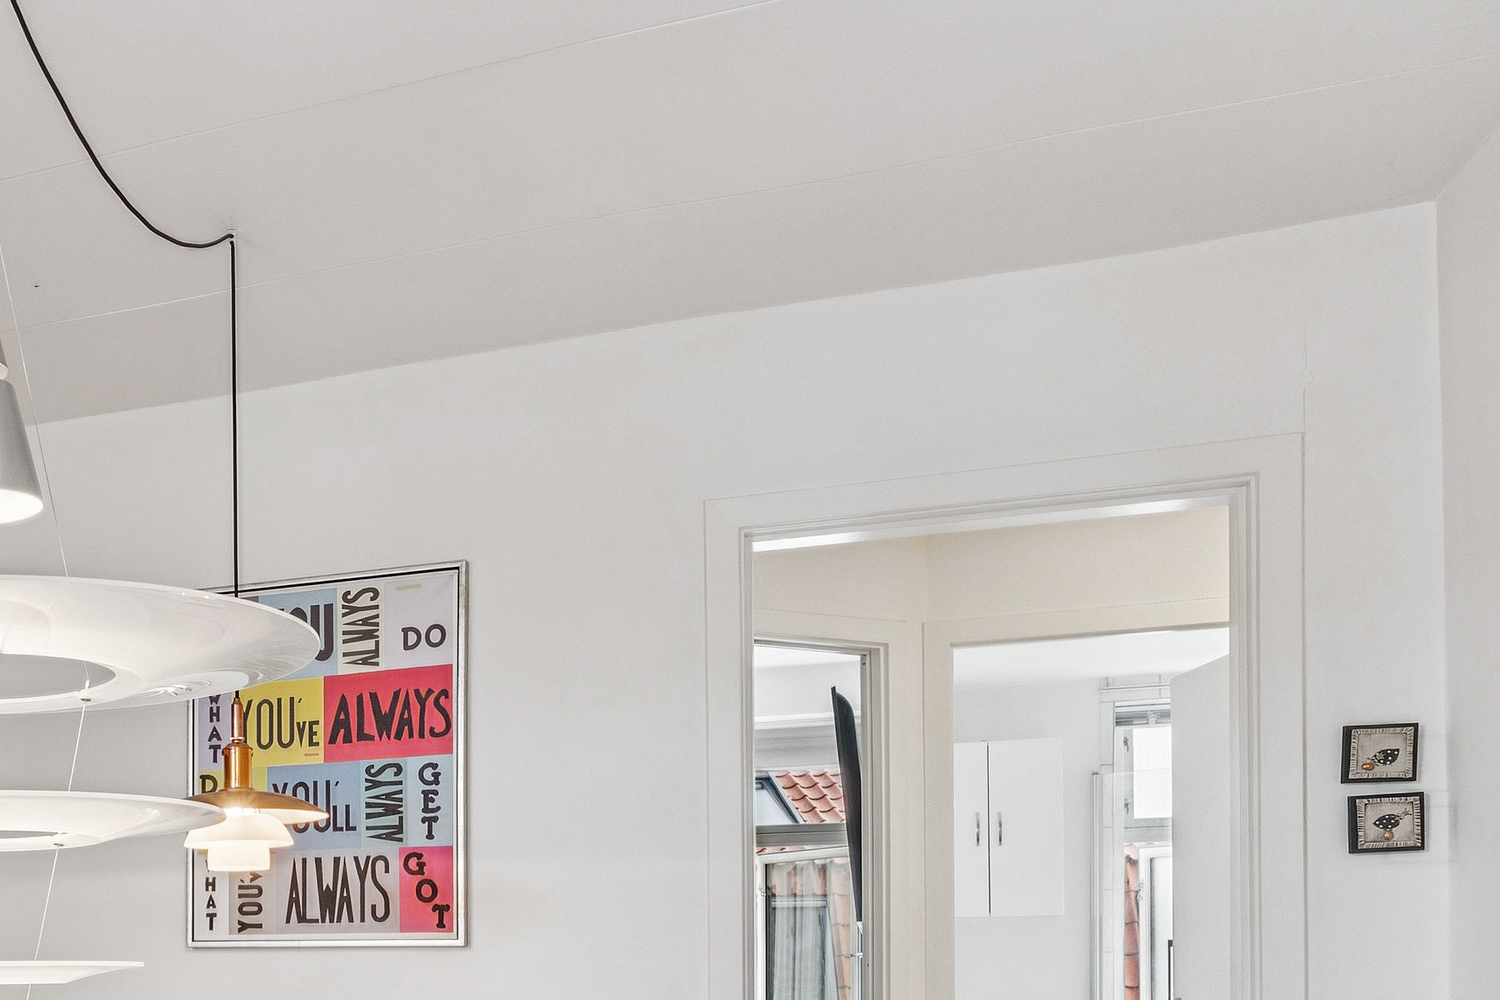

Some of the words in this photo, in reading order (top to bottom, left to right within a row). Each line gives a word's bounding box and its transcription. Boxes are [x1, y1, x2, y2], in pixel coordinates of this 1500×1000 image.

[341, 586, 381, 667] ALWAYS
[401, 623, 447, 651] DO
[328, 687, 452, 745] ALWAYS
[364, 762, 404, 843] ALWAYS
[417, 761, 442, 840] GET
[204, 860, 219, 931] HAT
[237, 871, 264, 933] YOU'V
[285, 854, 391, 925] ALWAYS
[403, 851, 450, 929] GOT
